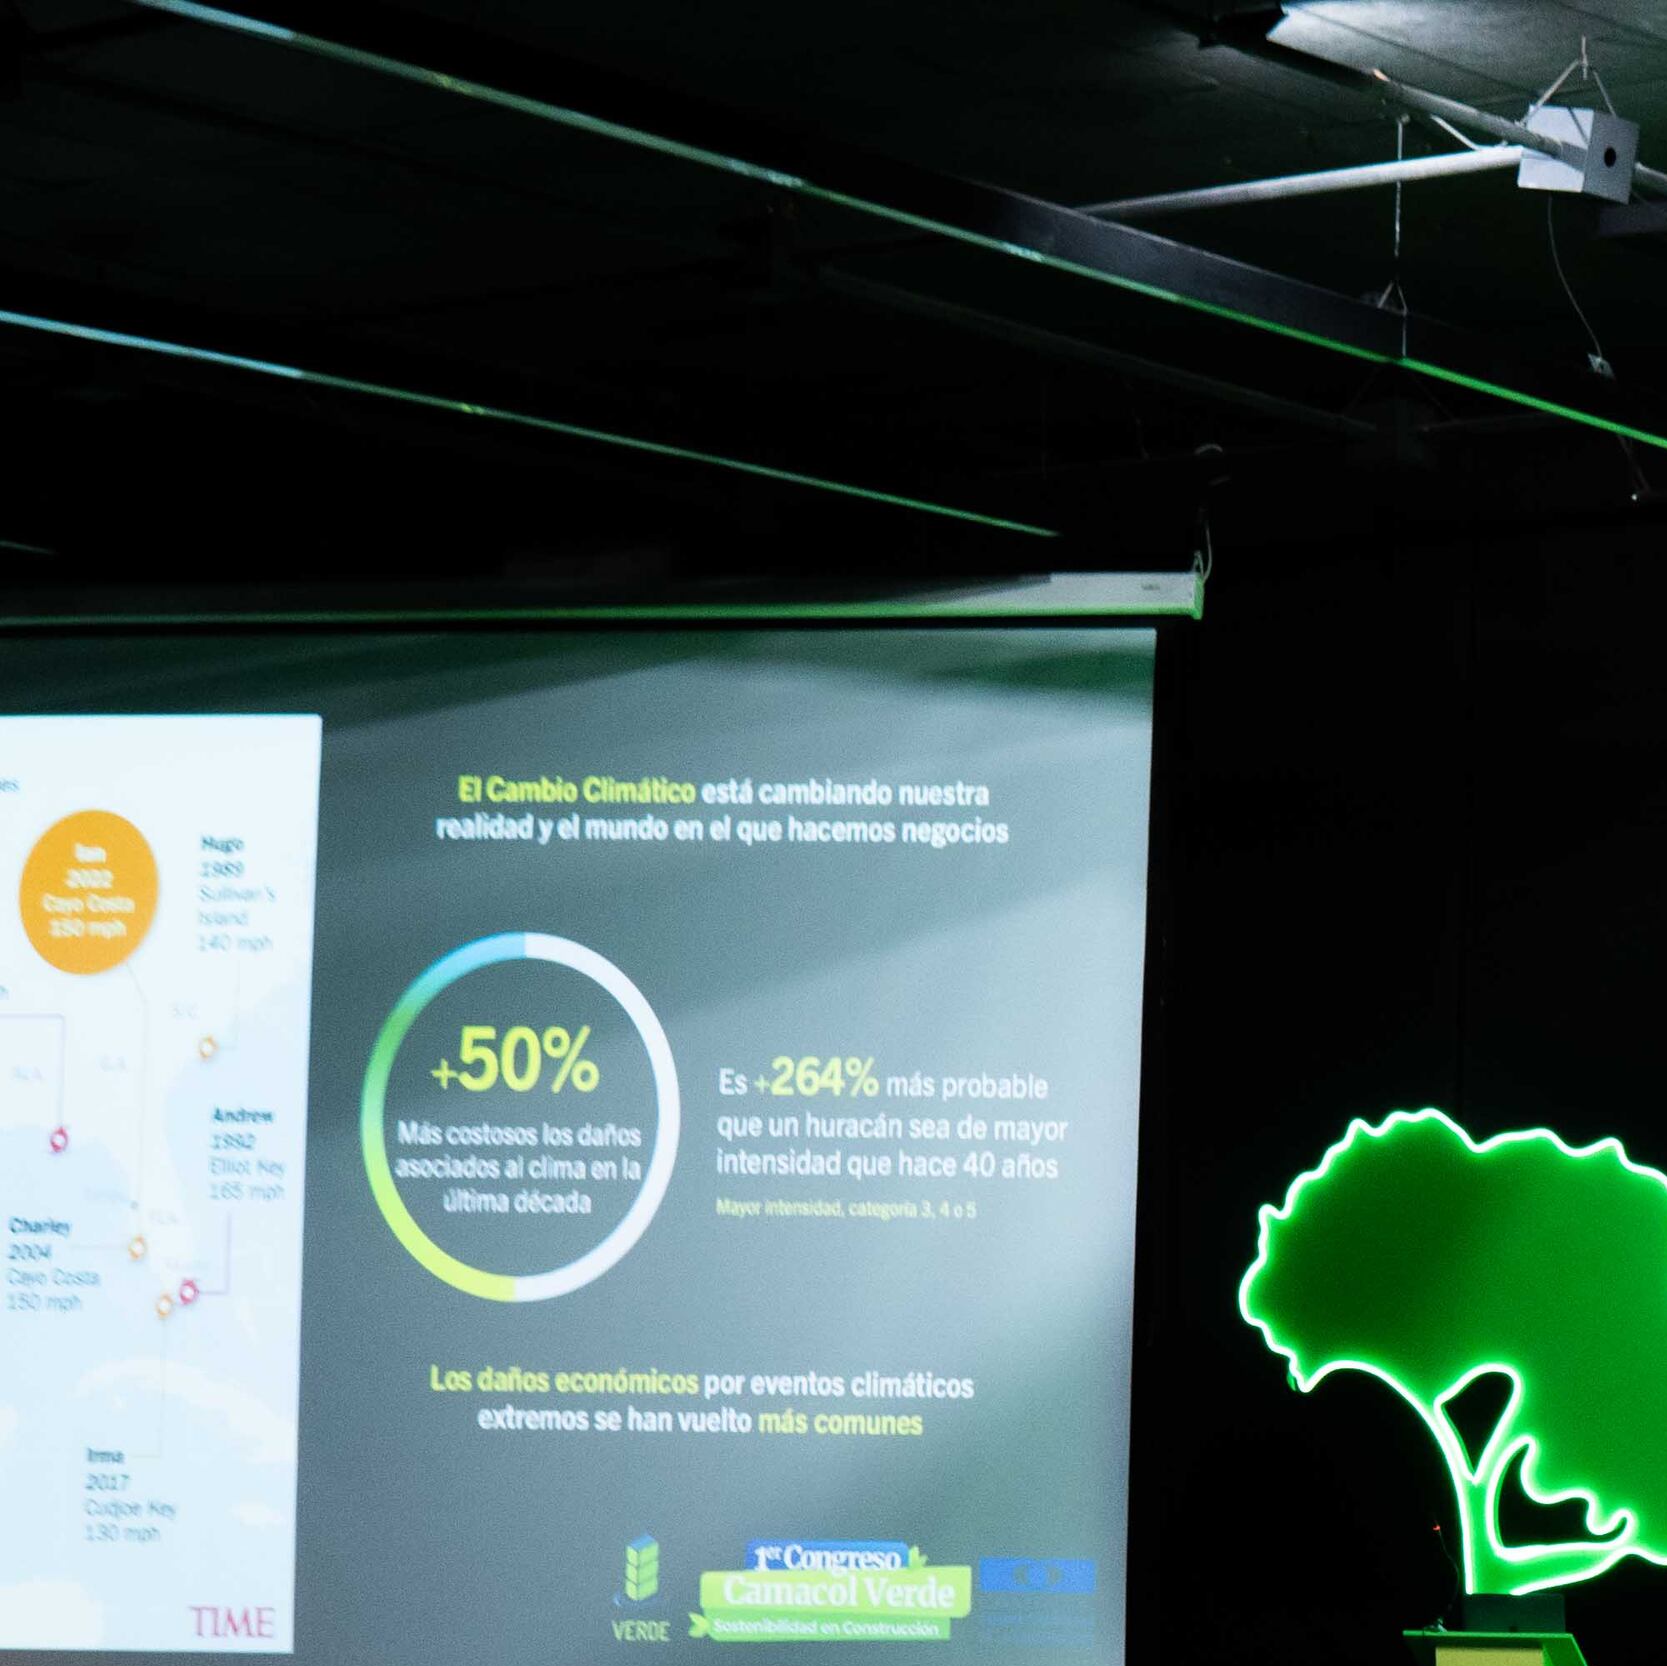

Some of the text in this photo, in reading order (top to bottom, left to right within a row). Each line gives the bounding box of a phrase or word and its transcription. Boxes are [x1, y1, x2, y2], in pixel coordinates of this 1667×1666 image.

[458, 774, 989, 806] El Cambio Climático está cambiando nuestra
[435, 812, 1009, 848] realidad y el mundo en el que hacemos negocios
[431, 1025, 600, 1094] +50%
[719, 1055, 1049, 1101] Es +264% más probable
[212, 1107, 273, 1123] Andrew
[716, 1111, 1069, 1146] que un huracán sea de mayor
[397, 1119, 642, 1147] Más costosos los daños
[394, 1154, 641, 1180] asociados al clima en la
[716, 1148, 1059, 1180] intensidad que hace 40 años
[443, 1188, 592, 1214] última década
[715, 1197, 761, 1218] Mayor
[764, 1198, 845, 1218] intensidad,
[848, 1199, 918, 1221] categoría
[940, 1202, 951, 1217] 4
[954, 1205, 963, 1218] o
[966, 1202, 977, 1218] 5
[430, 1364, 975, 1399] Los daños económicos por eventos climáticos
[477, 1404, 924, 1435] extremos se han vuelto más comunes
[85, 1473, 129, 1490] 2017
[783, 1544, 901, 1576] Congreso
[723, 1573, 955, 1608] Camacol Verde
[188, 1606, 275, 1638] TIME
[612, 1620, 671, 1641] VERDE
[714, 1618, 938, 1636] Sostenibilidad en Construcción
